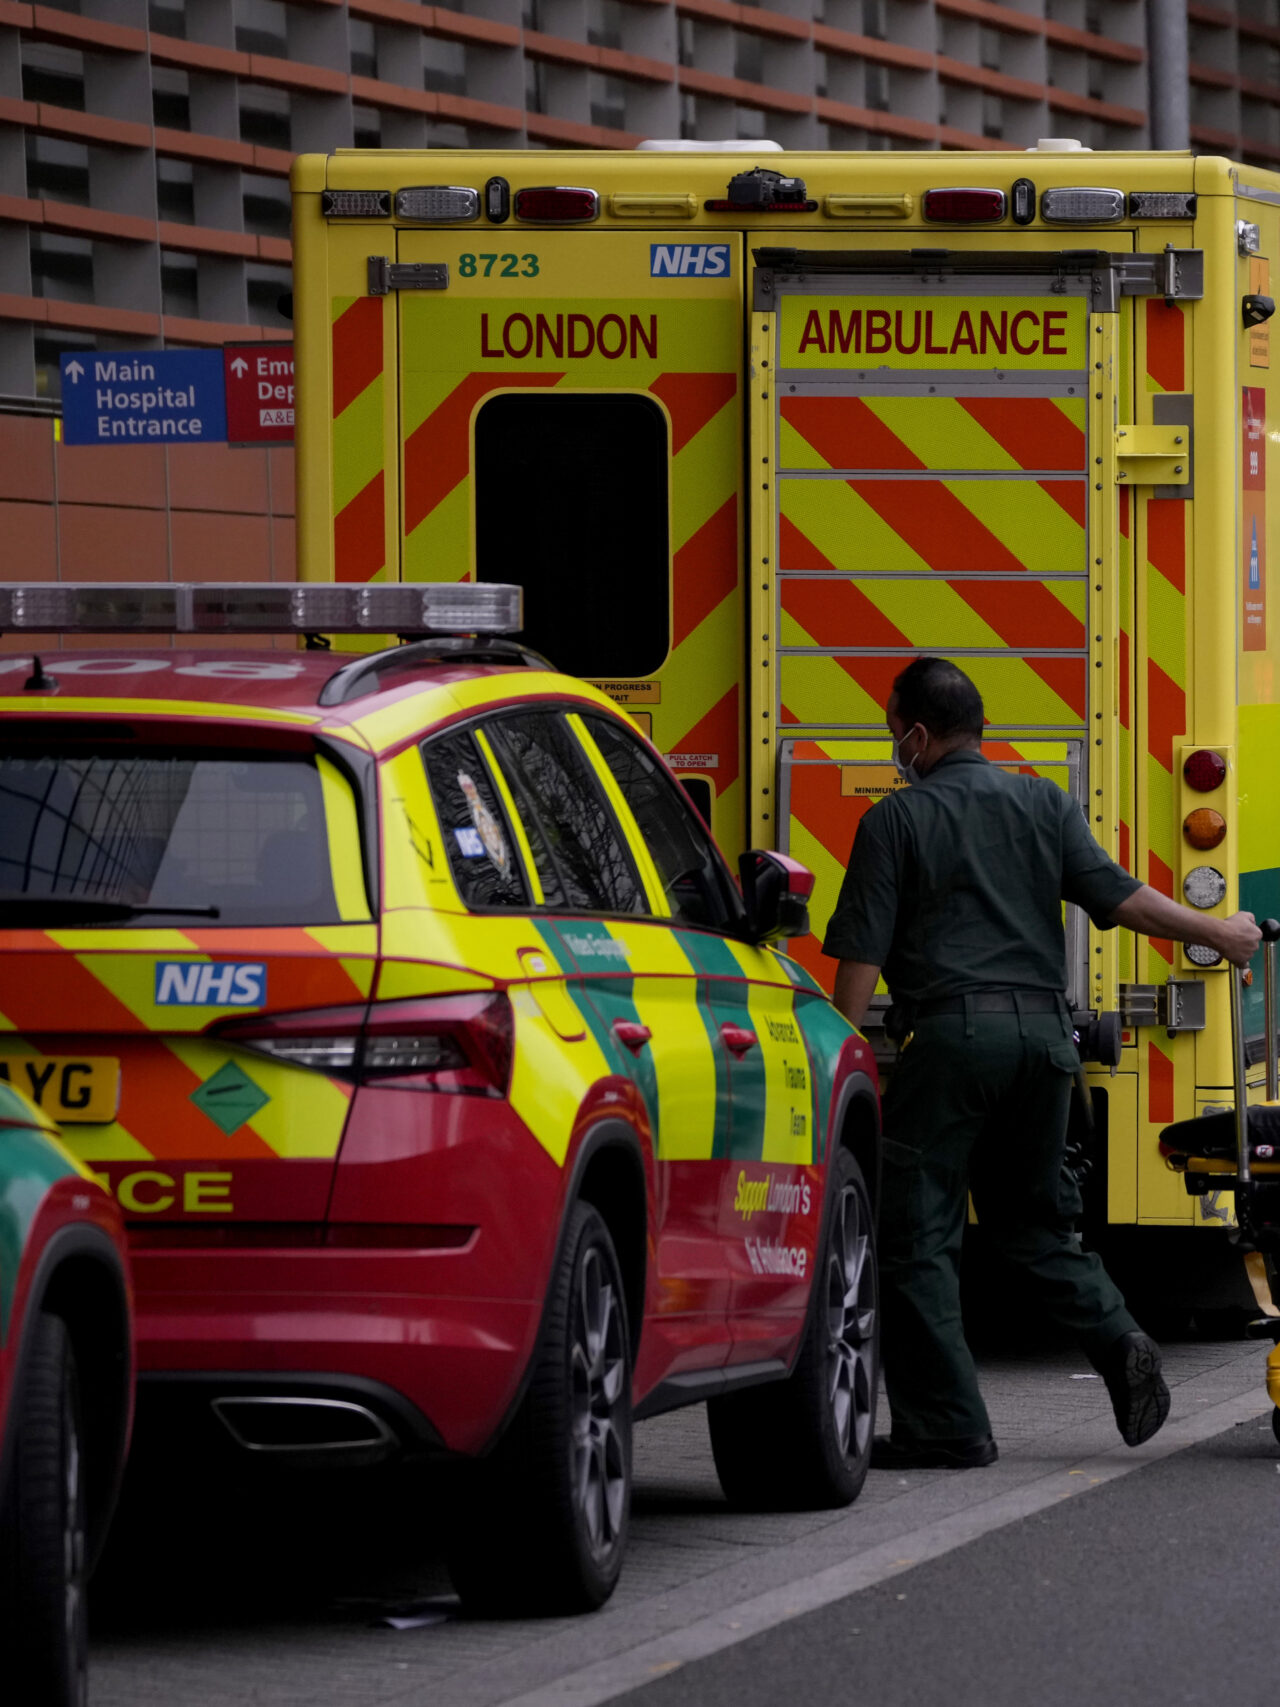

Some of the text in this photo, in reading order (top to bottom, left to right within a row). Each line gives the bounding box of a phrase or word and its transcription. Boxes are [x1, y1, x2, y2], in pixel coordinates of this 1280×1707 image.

[458, 253, 540, 278] 8723
[651, 245, 728, 276] NHS
[480, 312, 658, 360] LONDON
[798, 309, 1068, 356] AMBULANCE
[94, 360, 155, 382] Main
[96, 385, 196, 413] Hospital
[97, 416, 203, 437] Entrance
[261, 411, 295, 425] A&E
[604, 683, 652, 691] PROGRESS
[156, 963, 263, 1005] NHS
[0, 1061, 93, 1109] YG
[94, 1170, 234, 1214] CE
[734, 1169, 770, 1222] Support
